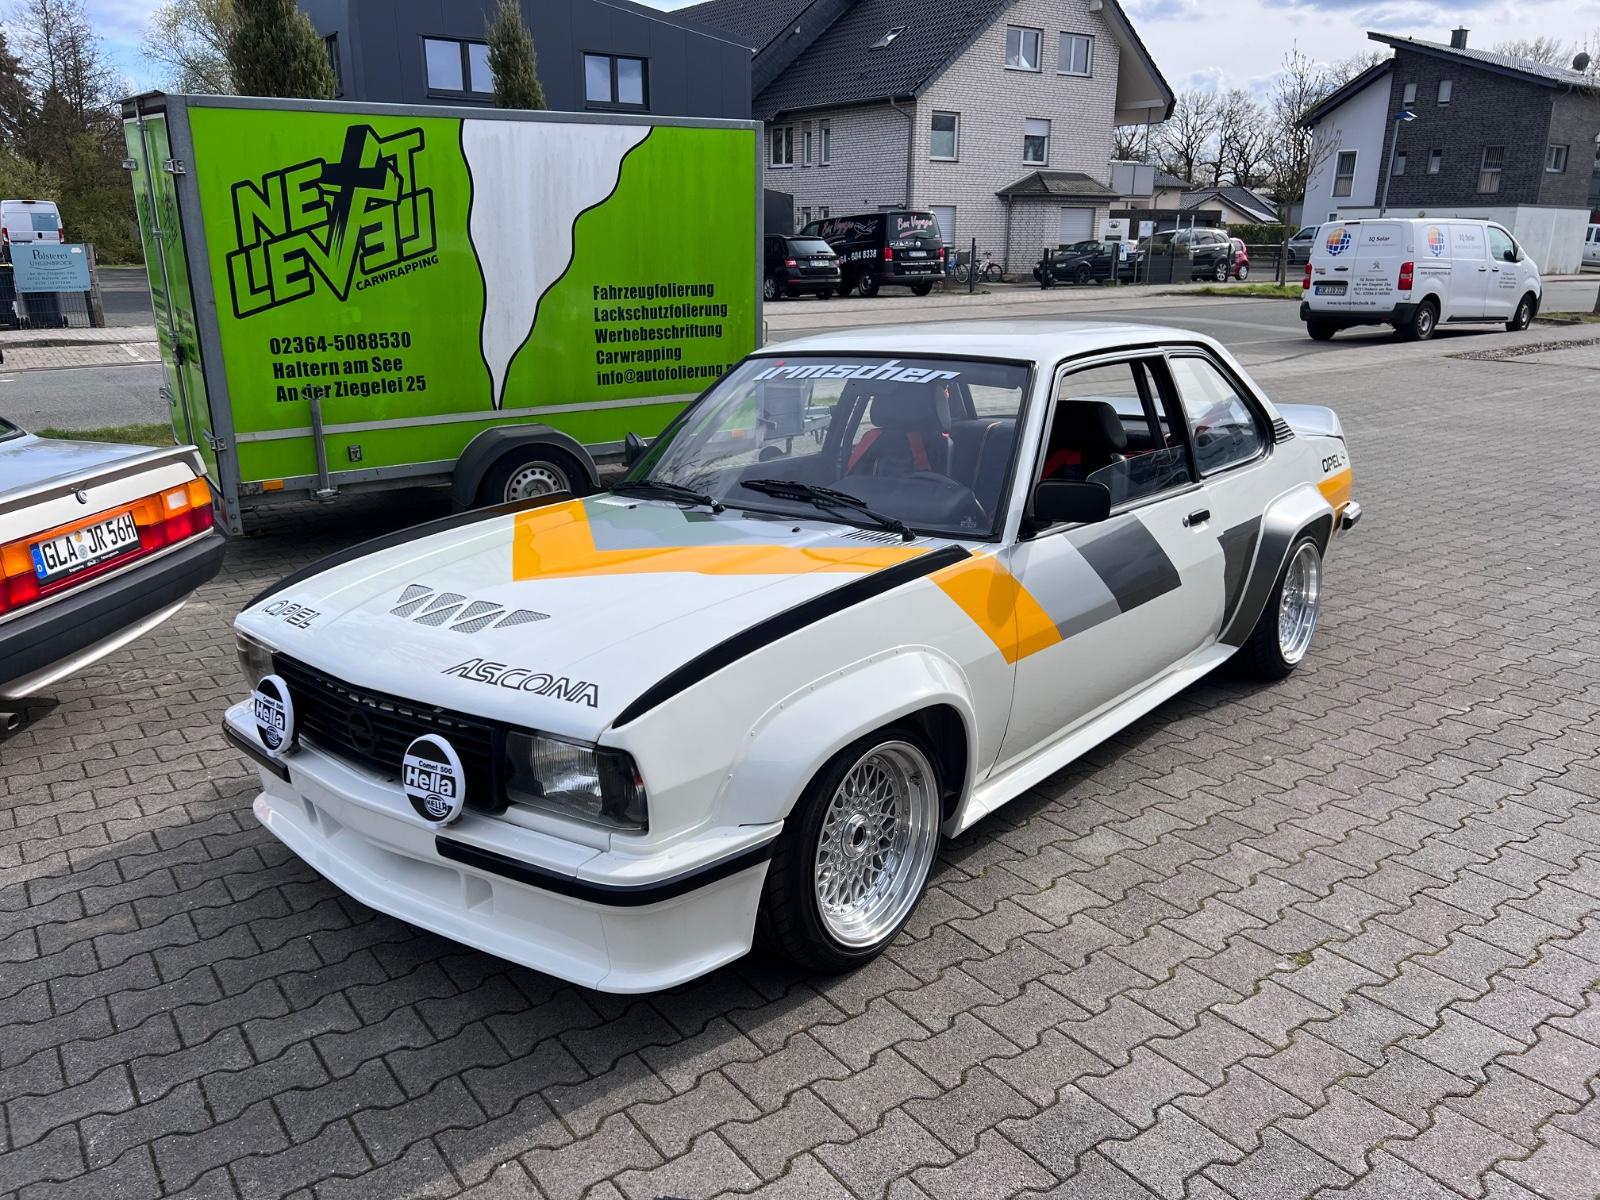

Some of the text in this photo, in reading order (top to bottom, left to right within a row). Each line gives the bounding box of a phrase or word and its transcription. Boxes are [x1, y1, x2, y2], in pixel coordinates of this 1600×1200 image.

[32, 249, 68, 260] Polsterei
[356, 254, 439, 291] CARWRAPPING
[593, 283, 714, 301] Fahrzeugfolierung
[594, 303, 728, 322] Lackschutzfolierung
[269, 331, 411, 355] 02364-5088530
[594, 324, 723, 344] Werbebeschriftung
[272, 356, 403, 379] Haltern am See
[596, 346, 682, 365] Carwrapping
[752, 360, 961, 384] irmscher
[276, 385, 299, 402] An
[334, 377, 403, 398] Ziegelei
[406, 375, 427, 392] 25
[42, 514, 136, 570] GLA JR 56H
[261, 600, 321, 629] OPEL
[441, 658, 599, 708] ASCONA
[256, 700, 284, 729] Hella
[406, 766, 453, 796] Hella
[440, 766, 453, 775] 500
[427, 799, 447, 812] HELLA
